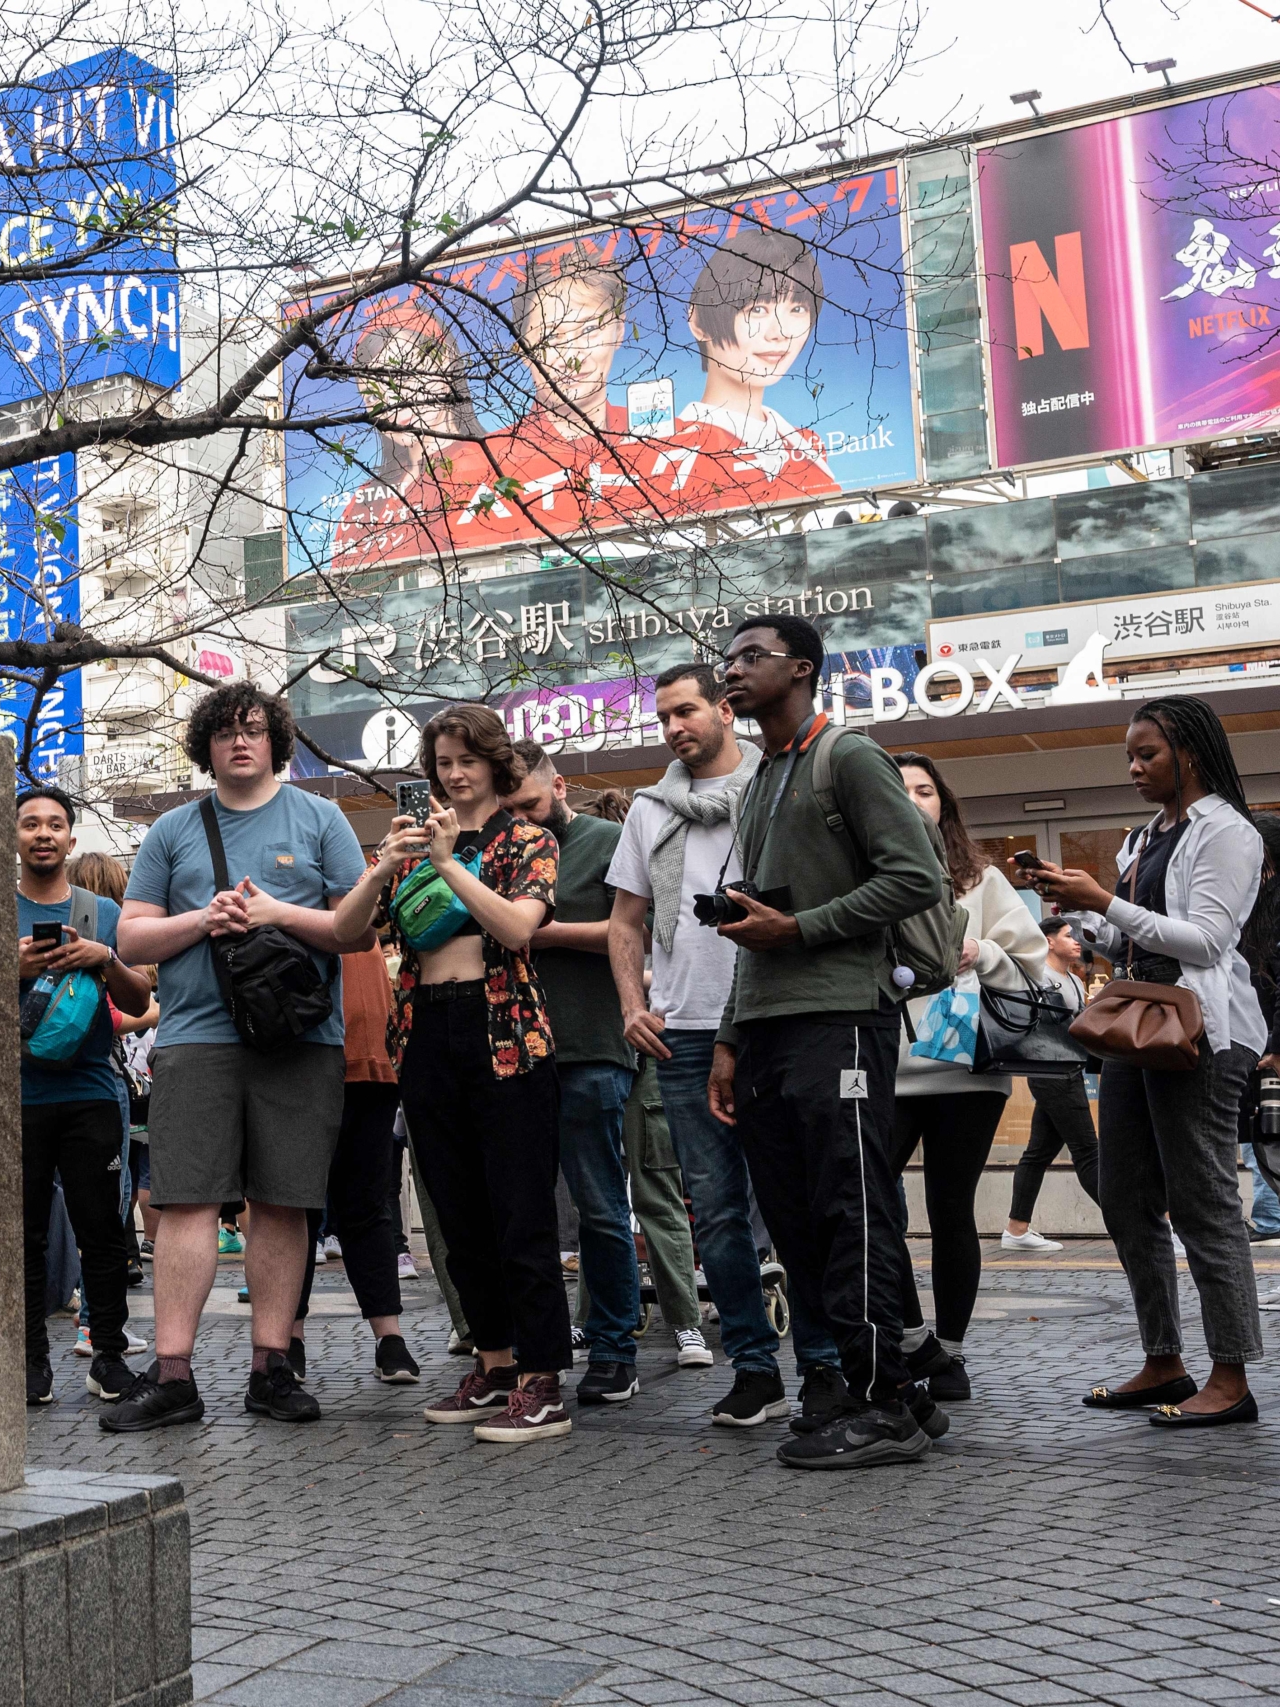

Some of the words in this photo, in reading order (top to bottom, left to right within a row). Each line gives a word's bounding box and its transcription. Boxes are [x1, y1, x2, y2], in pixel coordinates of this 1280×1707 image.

[32, 78, 116, 164] HIT
[1188, 306, 1271, 340] NETFLIX
[1021, 390, 1095, 417] 独占配信中
[776, 426, 896, 466] SoftBank
[355, 481, 408, 504] START
[1215, 602, 1252, 612] Shibuya
[1254, 598, 1273, 608] Sta.
[308, 622, 399, 684] JR
[411, 600, 575, 672] 渋谷駅
[588, 604, 733, 646] shibuya
[743, 583, 876, 622] station
[1113, 606, 1206, 641] 渋谷駅
[1216, 620, 1250, 631] 시부야역
[958, 639, 1002, 653] 東急電鉄
[870, 654, 1027, 723] BOX
[93, 752, 127, 766] DARTS
[106, 762, 127, 774] BAR
